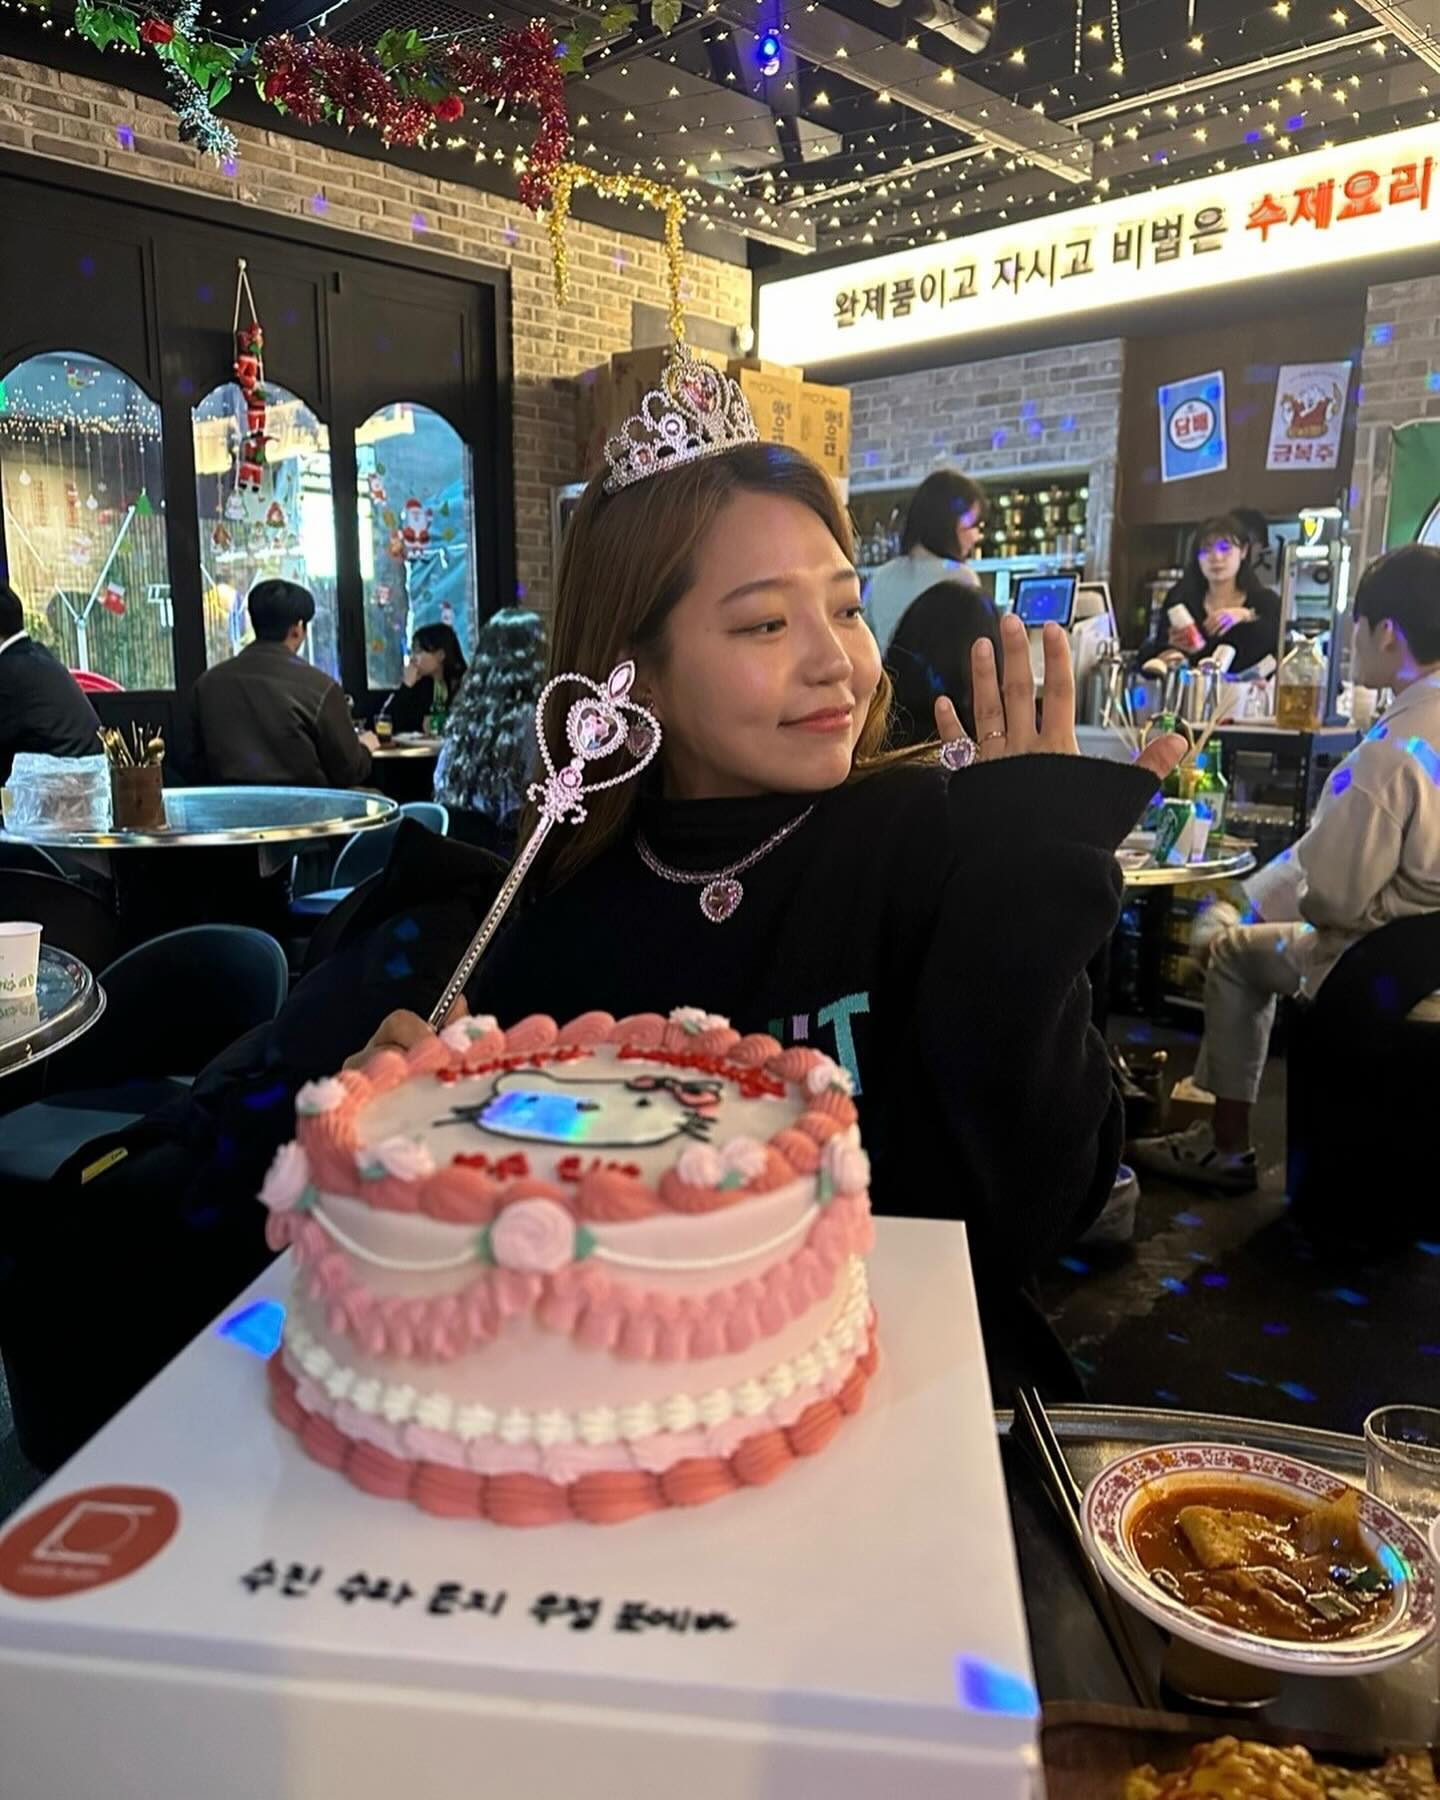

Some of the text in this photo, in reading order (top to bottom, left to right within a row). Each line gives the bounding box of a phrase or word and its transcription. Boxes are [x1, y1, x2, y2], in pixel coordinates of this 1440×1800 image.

[834, 156, 1433, 328] 완제품이고 자시고 비법은 수제요리
[1174, 411, 1209, 438] 담배
[1272, 443, 1335, 463] 금복주
